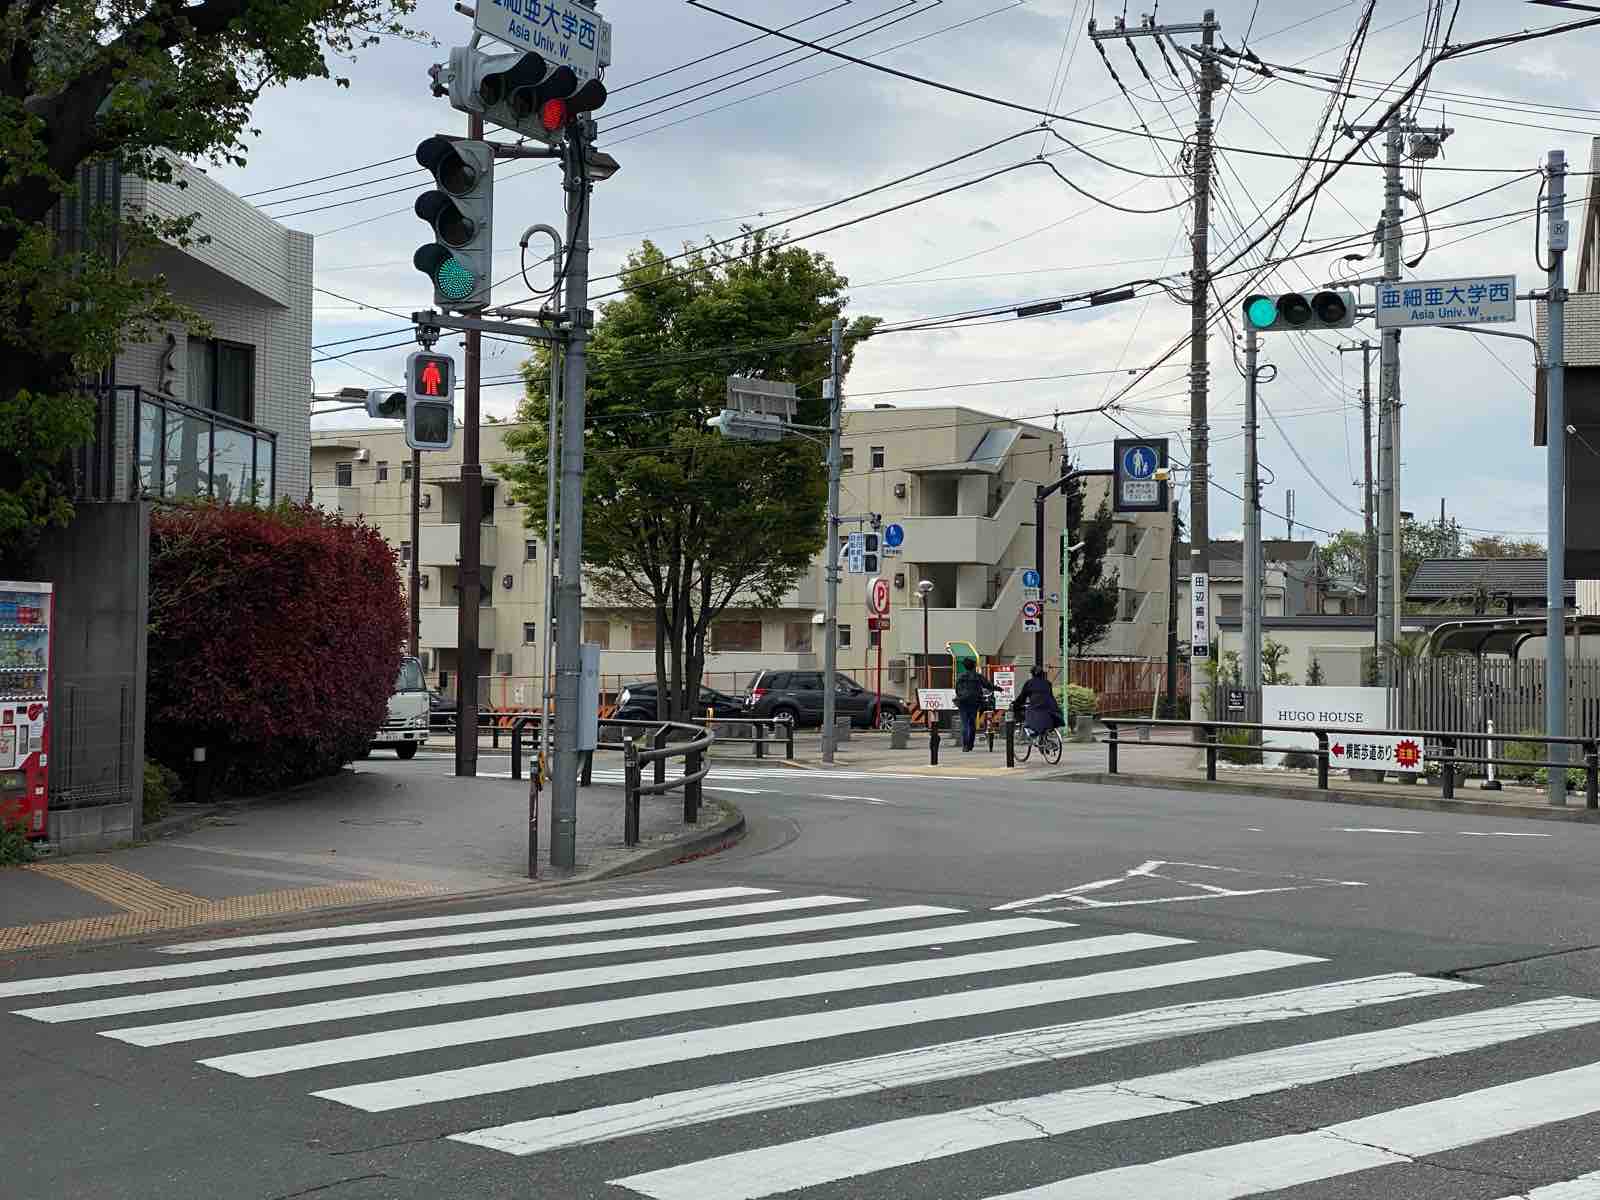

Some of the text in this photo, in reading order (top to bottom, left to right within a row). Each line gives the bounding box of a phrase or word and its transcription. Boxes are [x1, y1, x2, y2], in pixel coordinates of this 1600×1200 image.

[494, 0, 596, 50] 細亜大学西
[508, 19, 530, 41] Asia
[533, 30, 557, 56] Univ.
[1382, 283, 1510, 308] 亜細亜大学西
[1411, 310, 1434, 321] Asia
[1439, 306, 1466, 318] Univ.
[1279, 711, 1364, 723] HUGO HOUSE
[1346, 743, 1392, 760] 横断歩道あり
